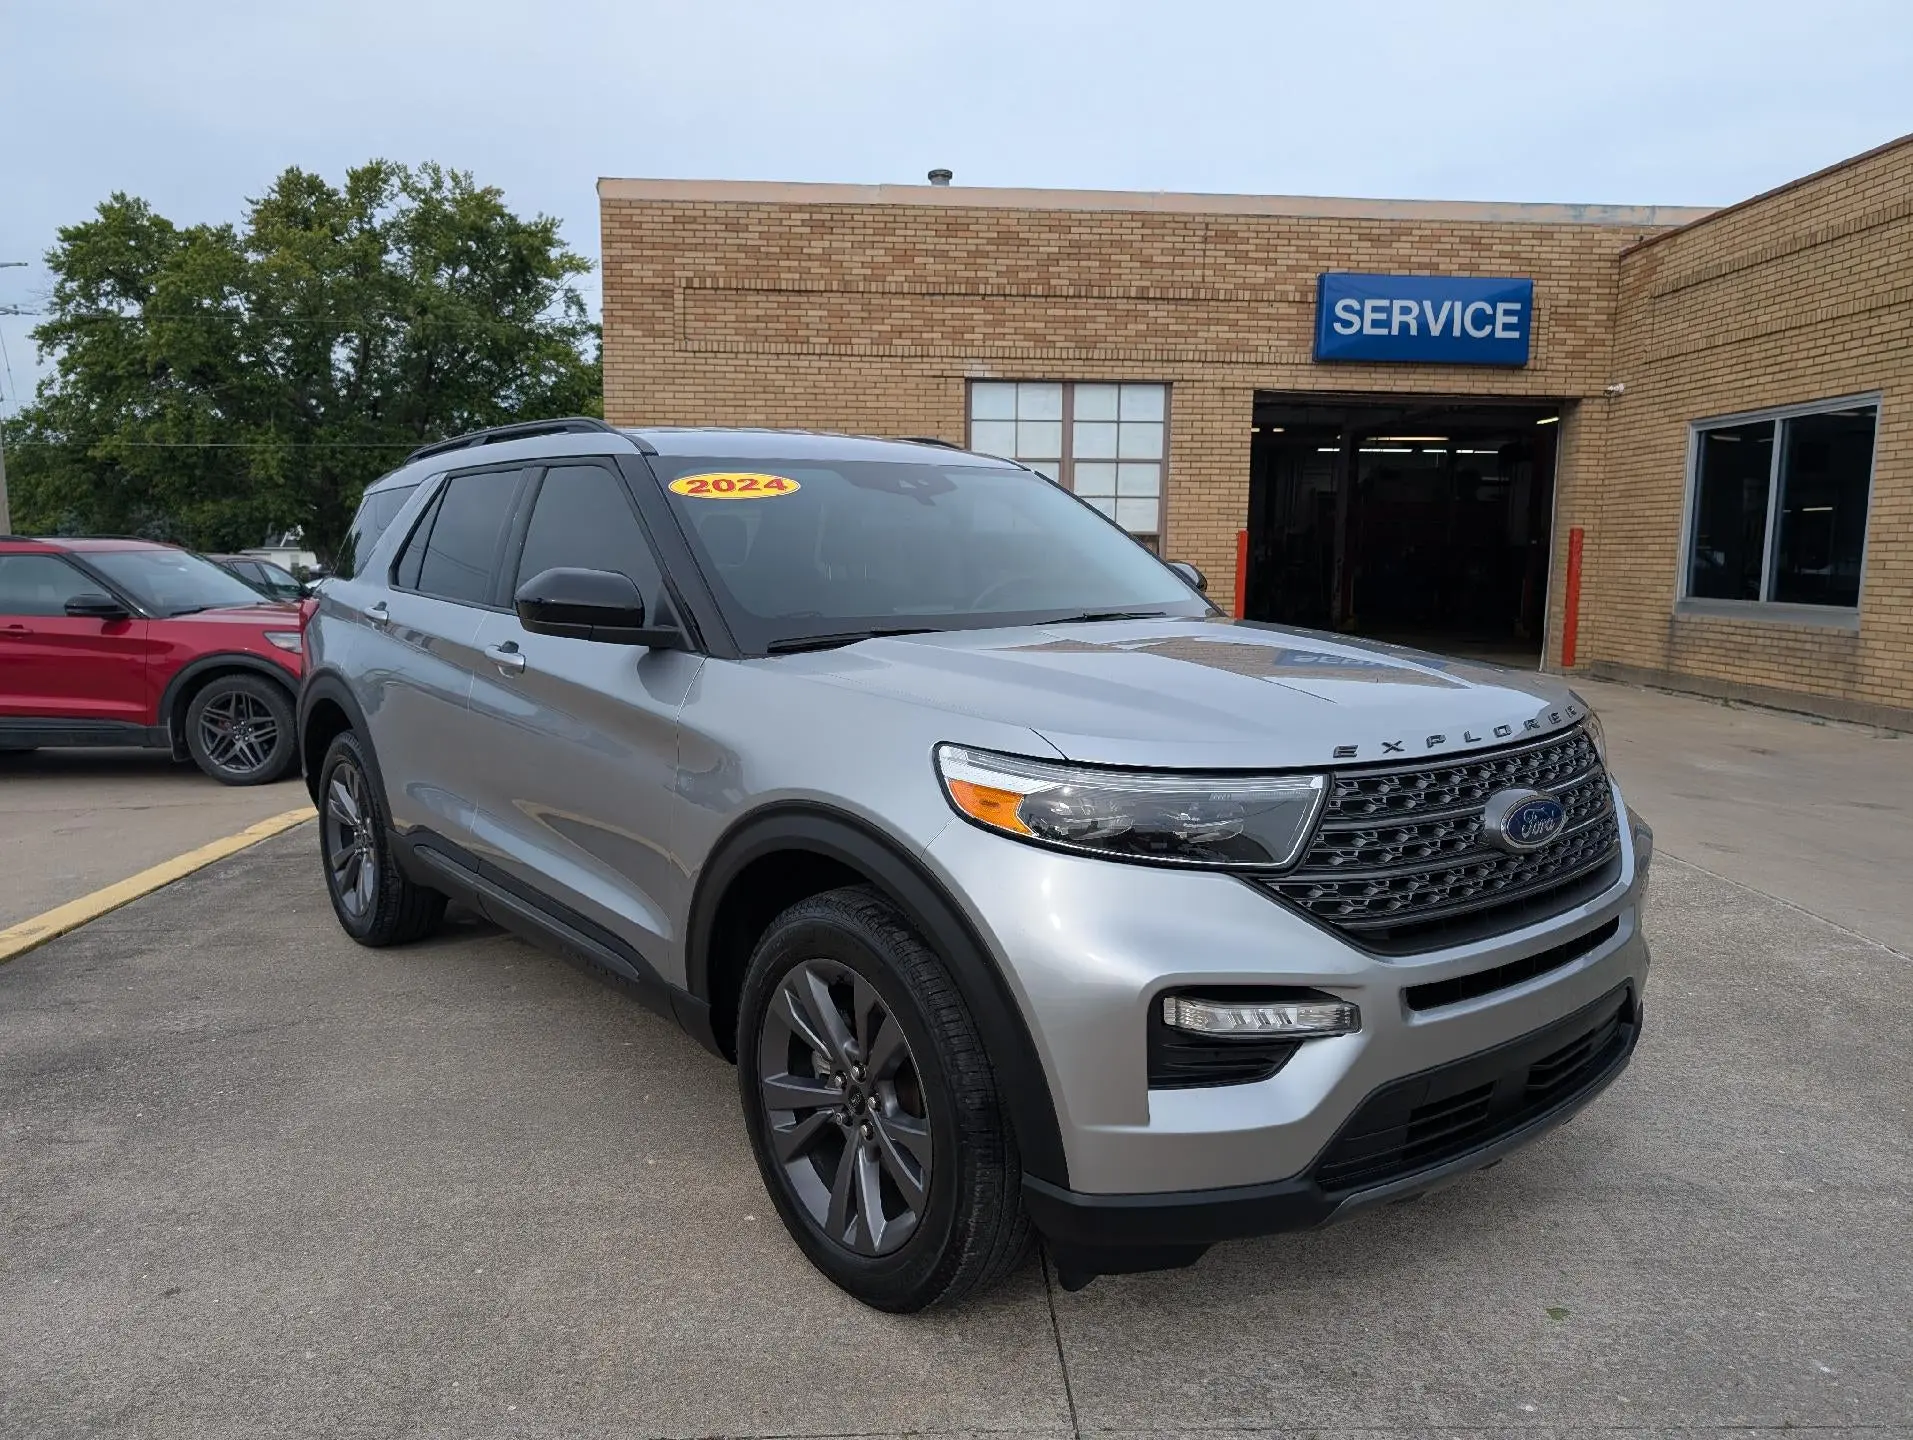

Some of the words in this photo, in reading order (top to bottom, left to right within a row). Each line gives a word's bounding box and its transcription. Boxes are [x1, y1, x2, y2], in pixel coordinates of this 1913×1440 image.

[1333, 298, 1521, 339] SERVICE
[686, 478, 788, 494] 2024
[1333, 703, 1577, 758] EXPLORER
[1521, 806, 1556, 839] Ford
